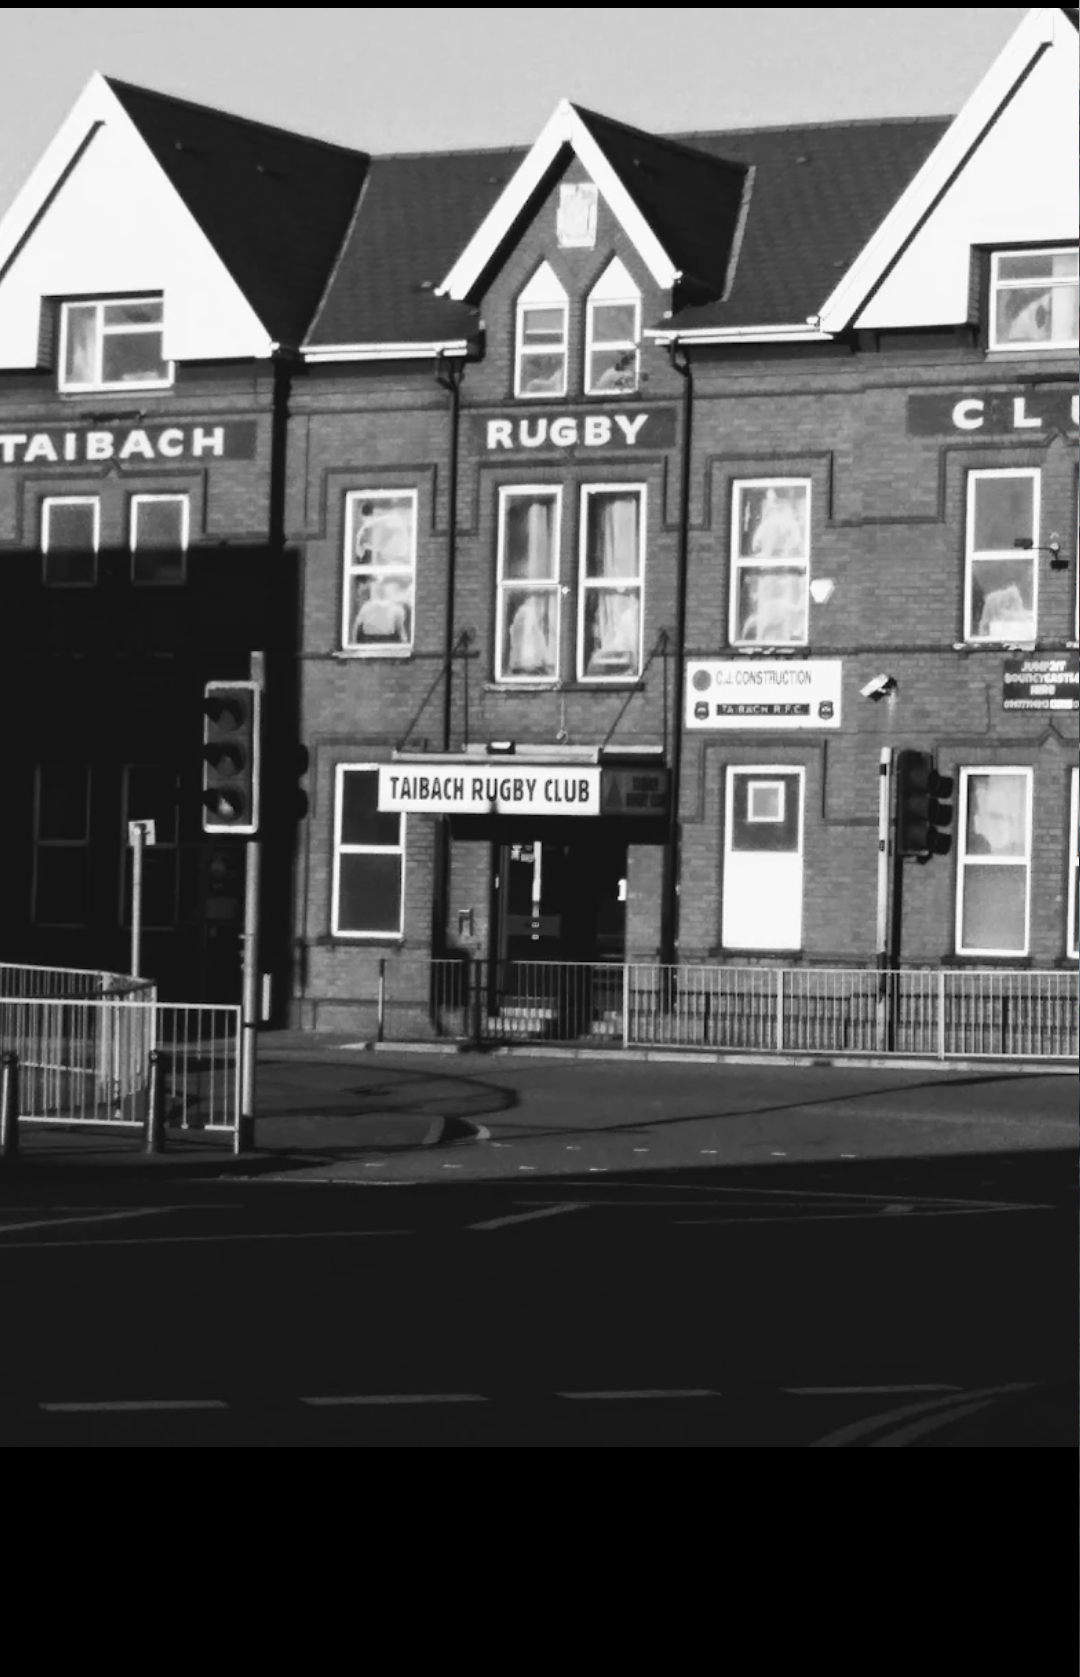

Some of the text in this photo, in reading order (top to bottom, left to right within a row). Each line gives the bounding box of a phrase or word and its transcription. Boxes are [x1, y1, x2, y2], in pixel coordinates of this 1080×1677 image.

[952, 394, 1079, 430] CL
[0, 427, 225, 463] TAIBACH
[487, 414, 649, 449] RUGBY
[735, 670, 812, 685] CONSTRUCTION
[722, 704, 769, 714] TABACH
[391, 776, 590, 803] TAIBACH RUGBY CLUB
